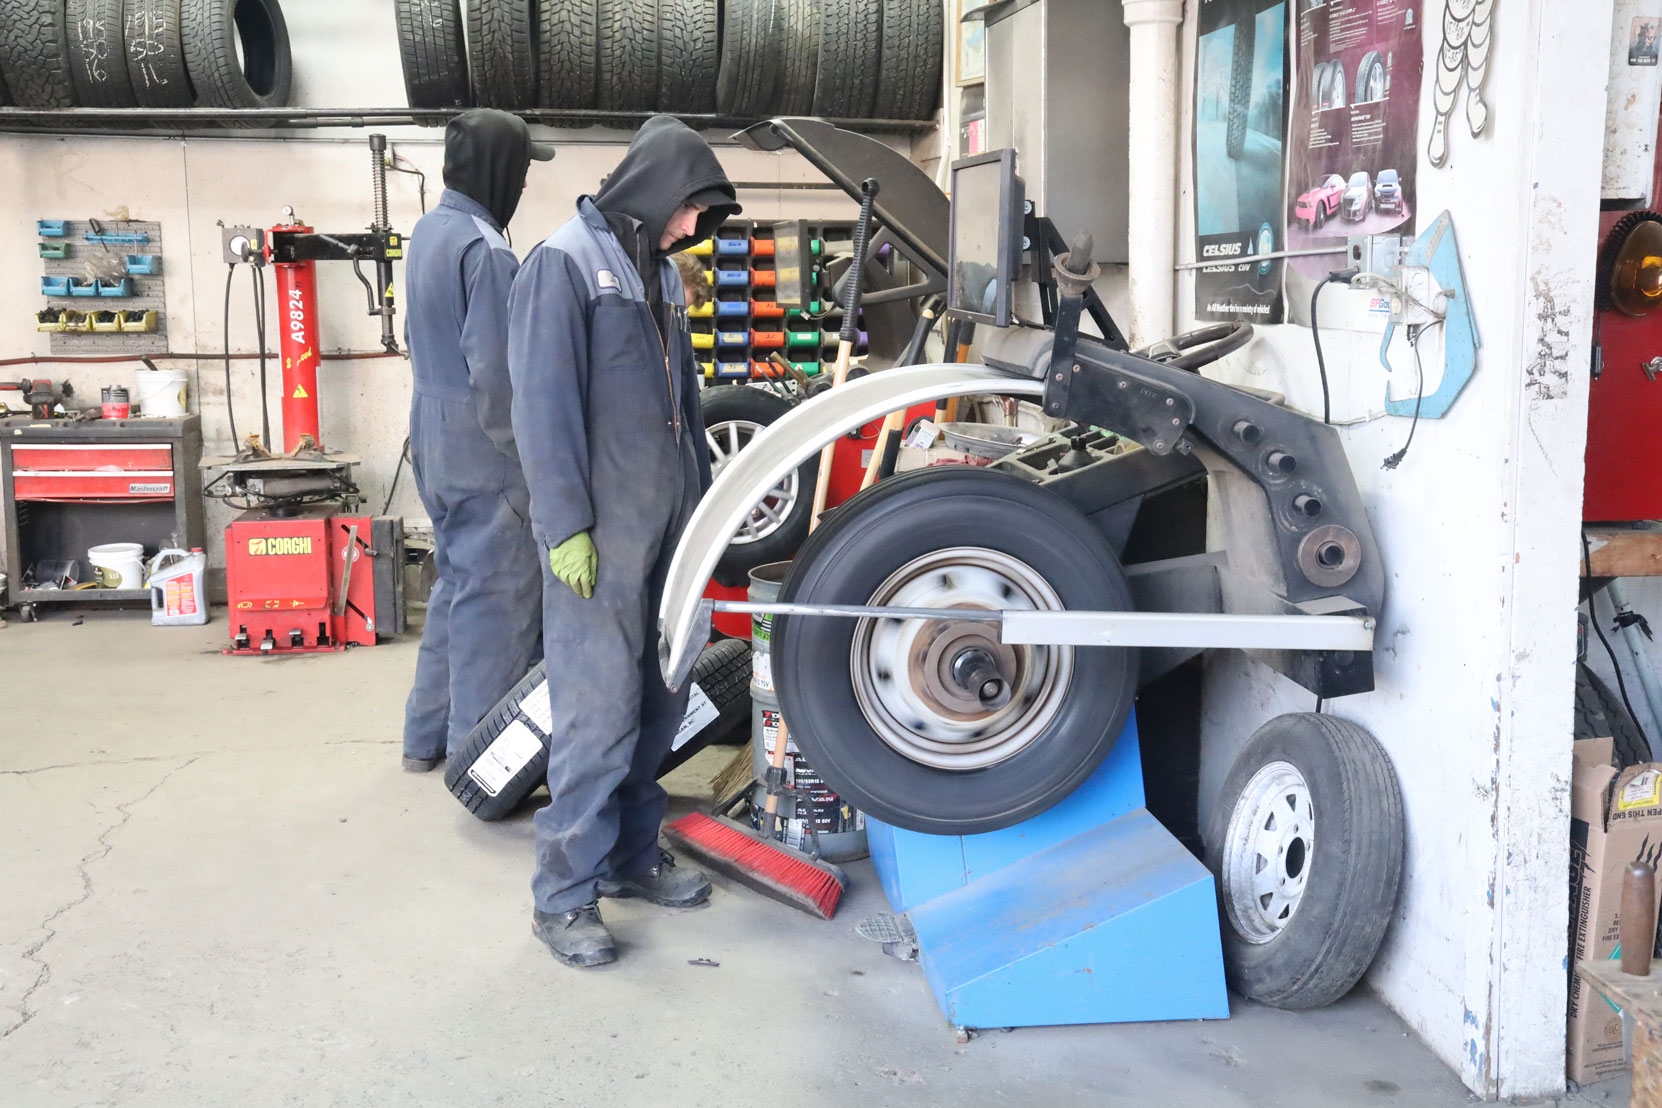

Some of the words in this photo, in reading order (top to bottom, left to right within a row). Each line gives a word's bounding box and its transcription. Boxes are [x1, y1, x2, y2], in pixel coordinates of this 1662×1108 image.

[1203, 243, 1242, 256] CELSIUS
[267, 537, 312, 555] CORGHI
[1612, 812, 1626, 820] END
[1628, 810, 1645, 819] THIS
[1647, 808, 1662, 816] PEN
[1577, 886, 1592, 943] EXTINGUISHER
[1608, 926, 1618, 934] DRY
[1576, 942, 1585, 961] FIRE
[1572, 968, 1582, 1000] CHEMI
[1570, 1002, 1579, 1018] DRY
